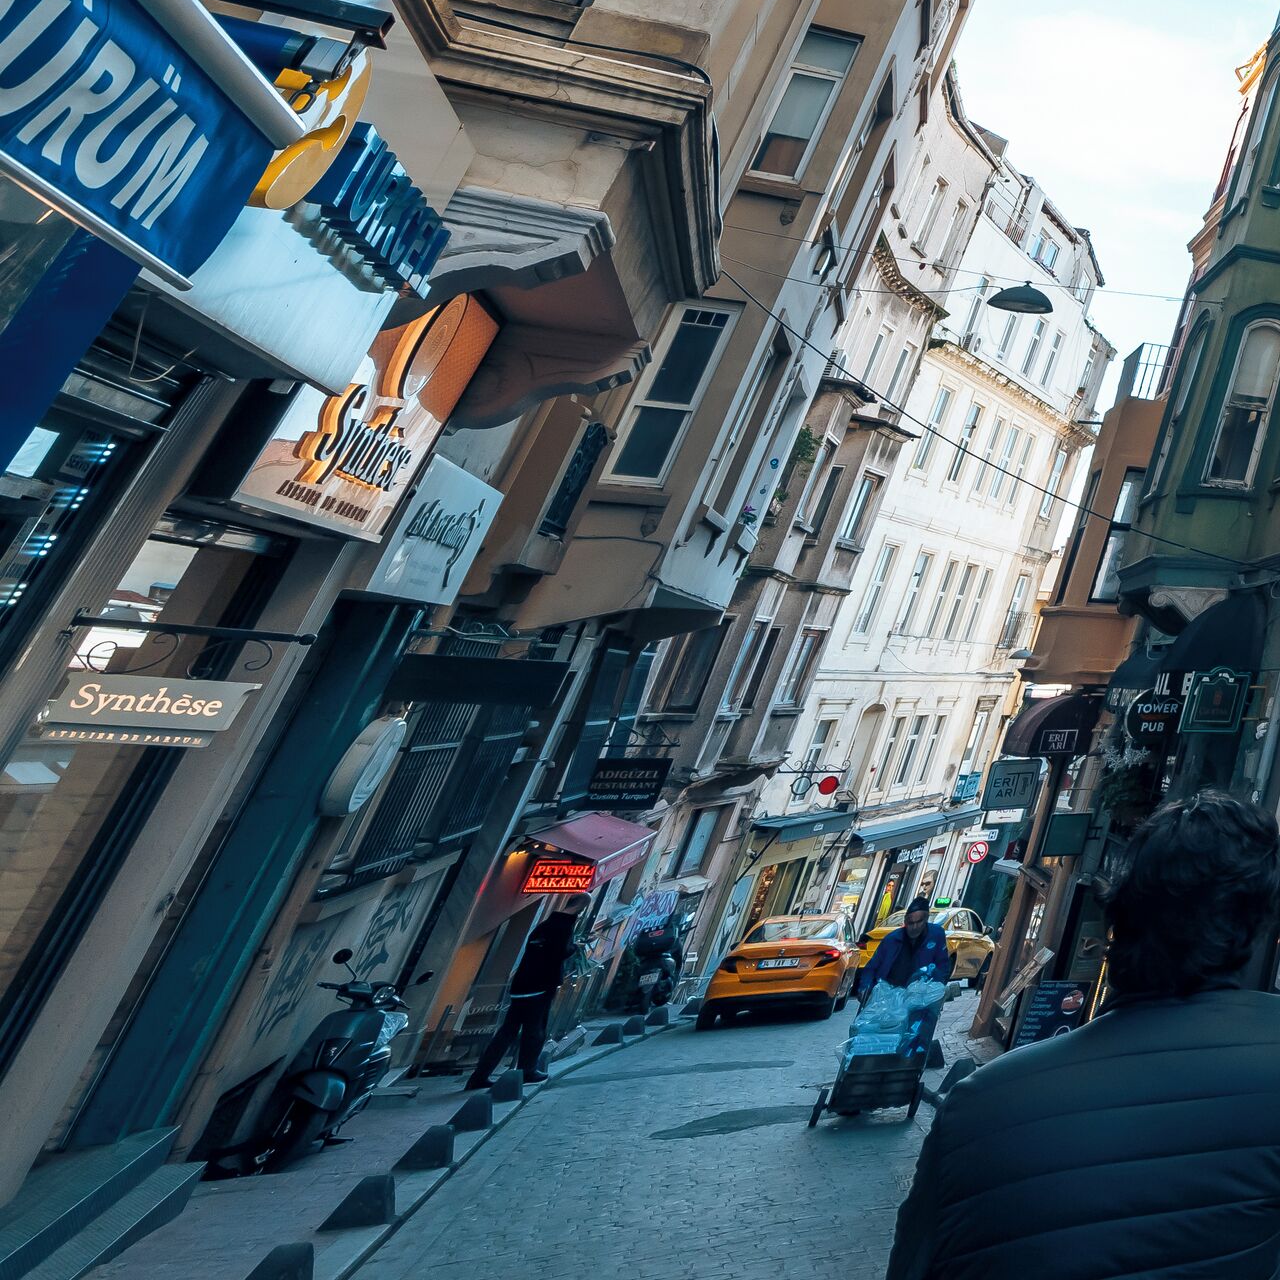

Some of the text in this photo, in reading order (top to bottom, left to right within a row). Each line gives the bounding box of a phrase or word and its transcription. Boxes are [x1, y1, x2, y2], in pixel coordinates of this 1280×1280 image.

[1137, 703, 1179, 714] TOWER
[1140, 721, 1165, 733] PUB
[49, 730, 202, 746] ATELIER DE PARFUM
